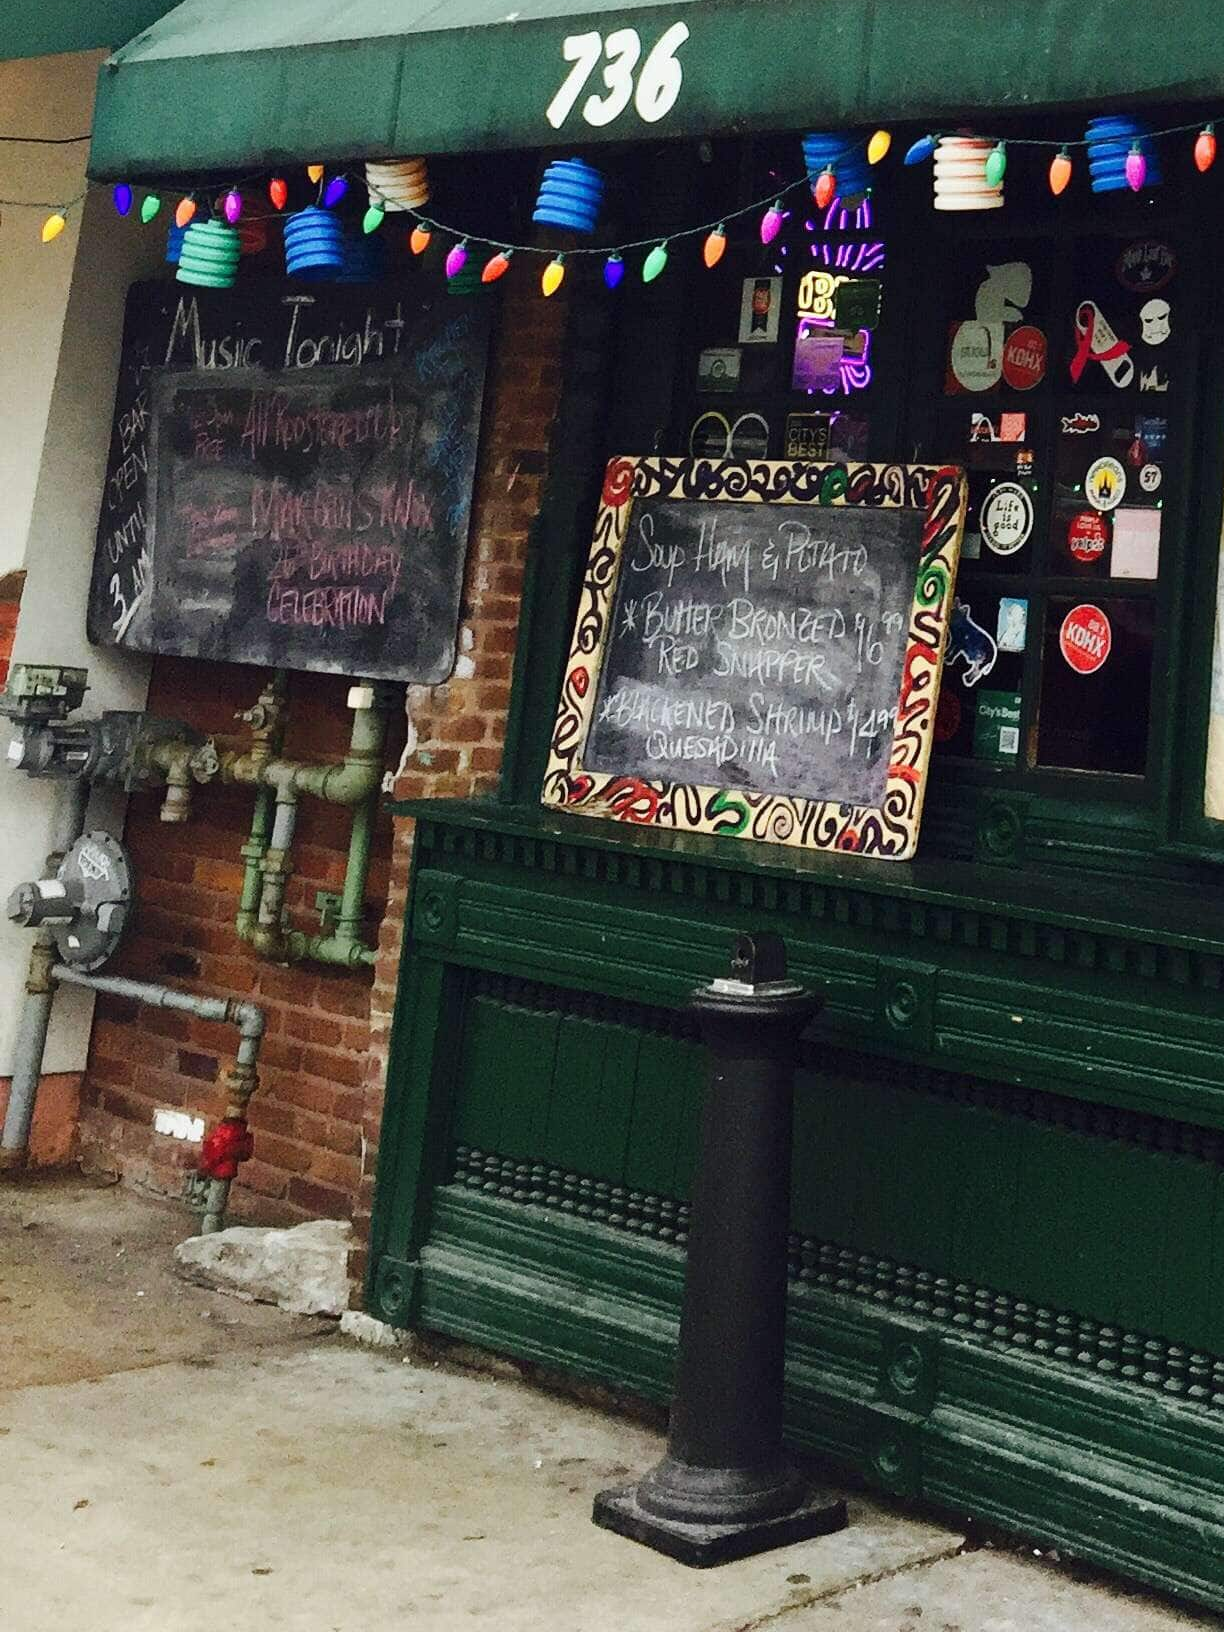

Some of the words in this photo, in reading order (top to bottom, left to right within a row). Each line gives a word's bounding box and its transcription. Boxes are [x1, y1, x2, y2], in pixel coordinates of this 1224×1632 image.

[545, 20, 691, 130] 736
[164, 295, 262, 370] Music
[281, 294, 405, 369] Tonight
[1007, 345, 1044, 373] KDHX
[996, 500, 1020, 513] Life
[993, 519, 1019, 538] good
[631, 513, 686, 588] Soup
[652, 635, 699, 675] RED
[1065, 621, 1107, 658] KDHX
